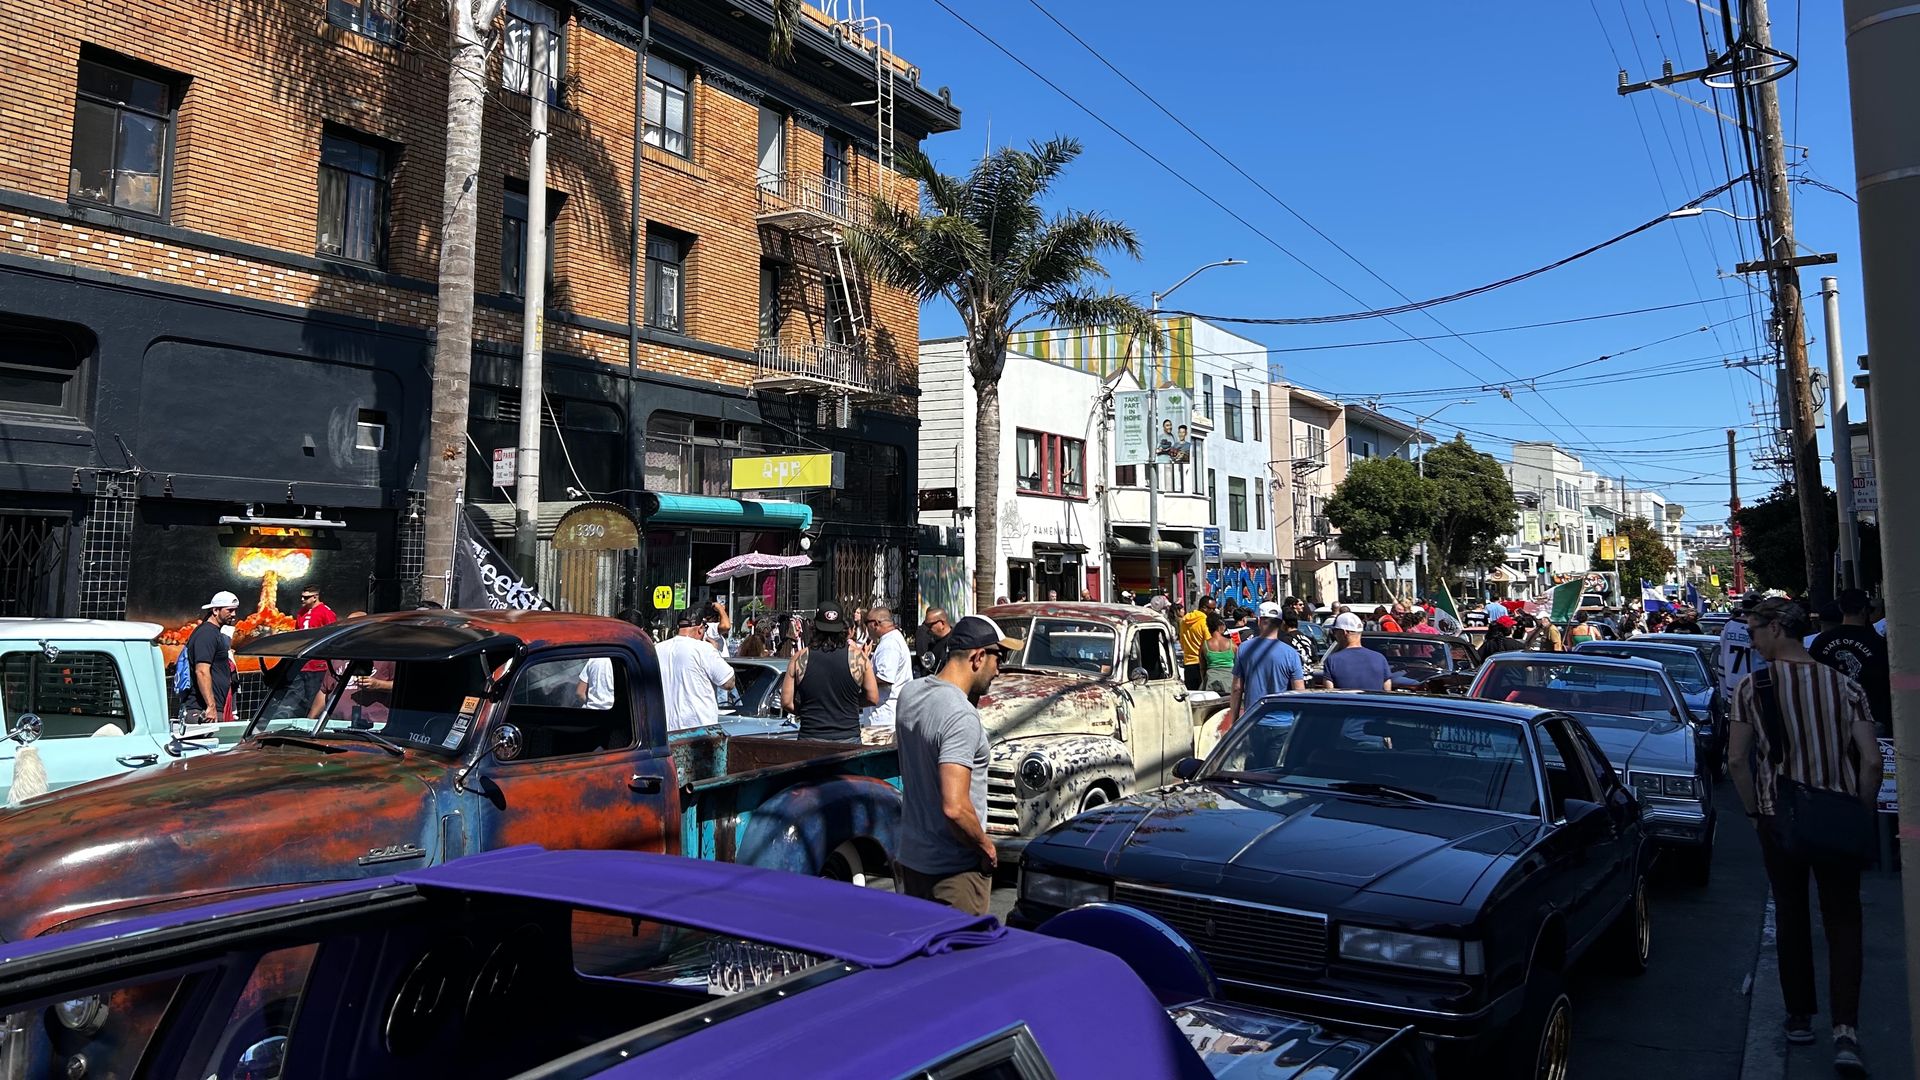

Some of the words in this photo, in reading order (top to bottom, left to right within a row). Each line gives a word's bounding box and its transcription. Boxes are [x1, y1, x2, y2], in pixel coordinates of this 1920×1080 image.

[1853, 478, 1864, 488] NO
[576, 523, 604, 538] 3390
[1822, 638, 1841, 656] STATE
[1854, 641, 1873, 657] FLUX
[1729, 645, 1751, 673] 71
